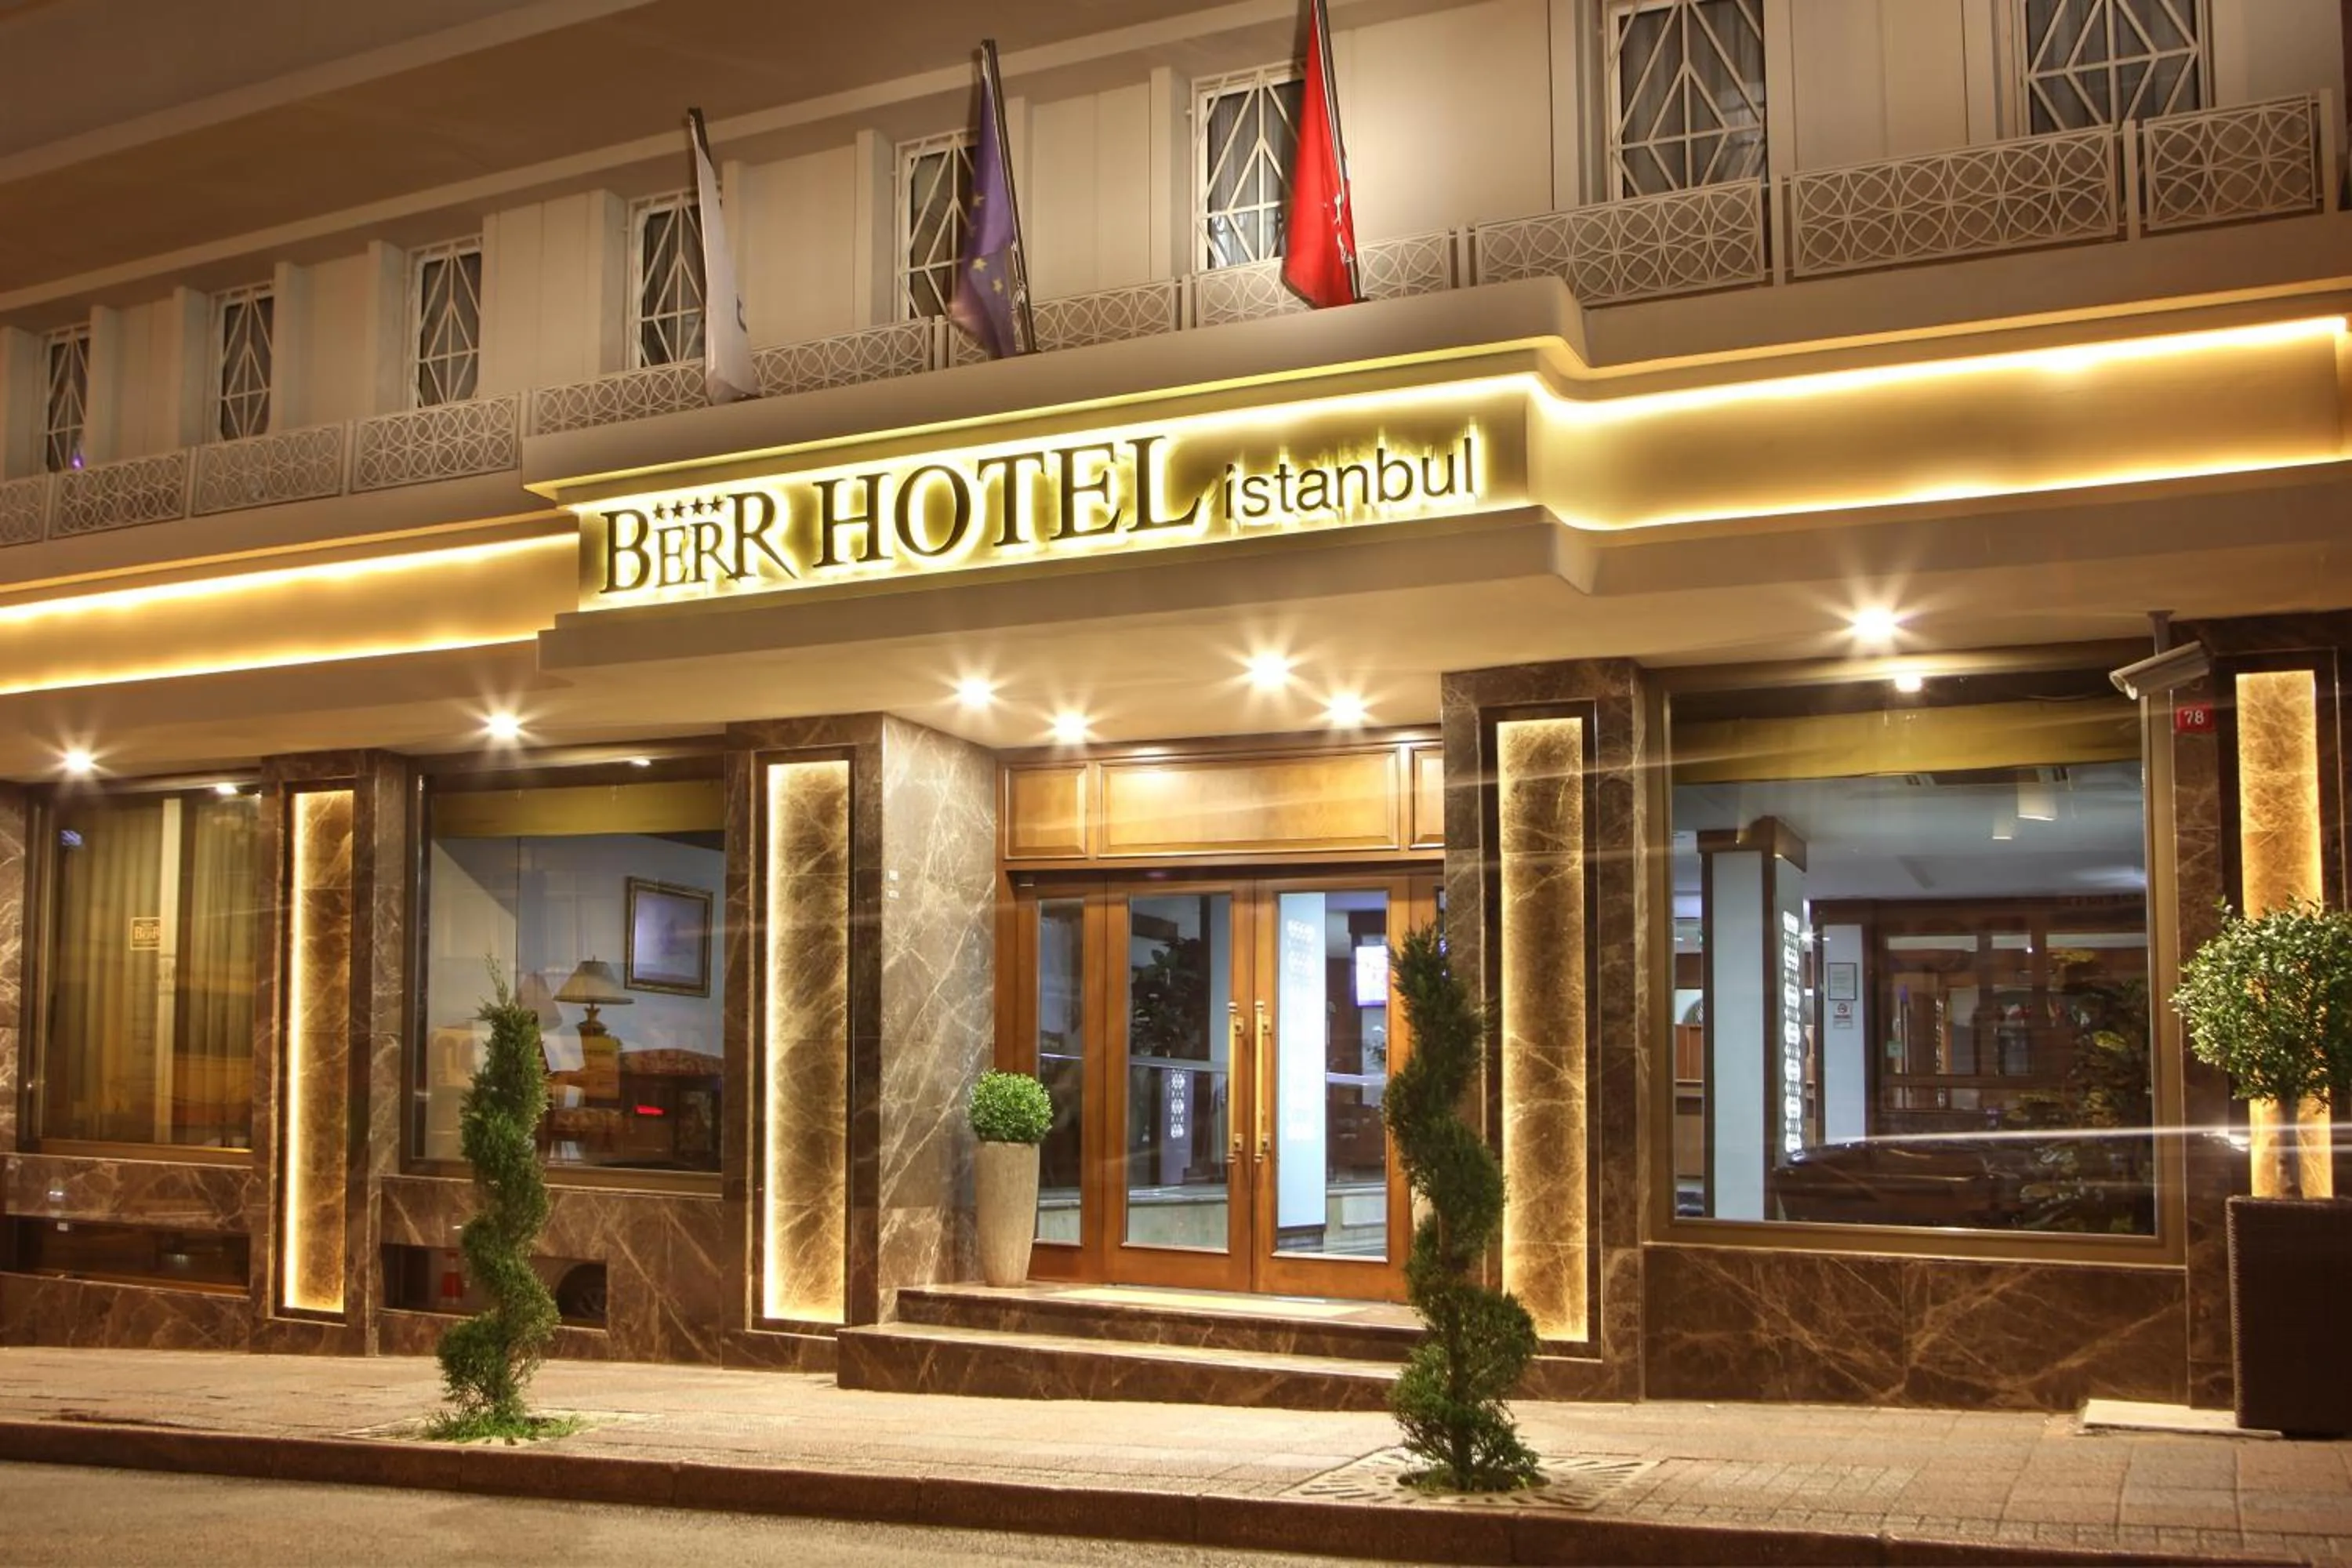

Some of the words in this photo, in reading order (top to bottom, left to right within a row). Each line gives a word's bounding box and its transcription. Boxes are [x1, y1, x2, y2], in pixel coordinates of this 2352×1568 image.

[600, 493, 798, 593] BERR
[812, 436, 1200, 568] HOTEL
[1225, 436, 1473, 519] istanbul
[2184, 710, 2205, 725] 78
